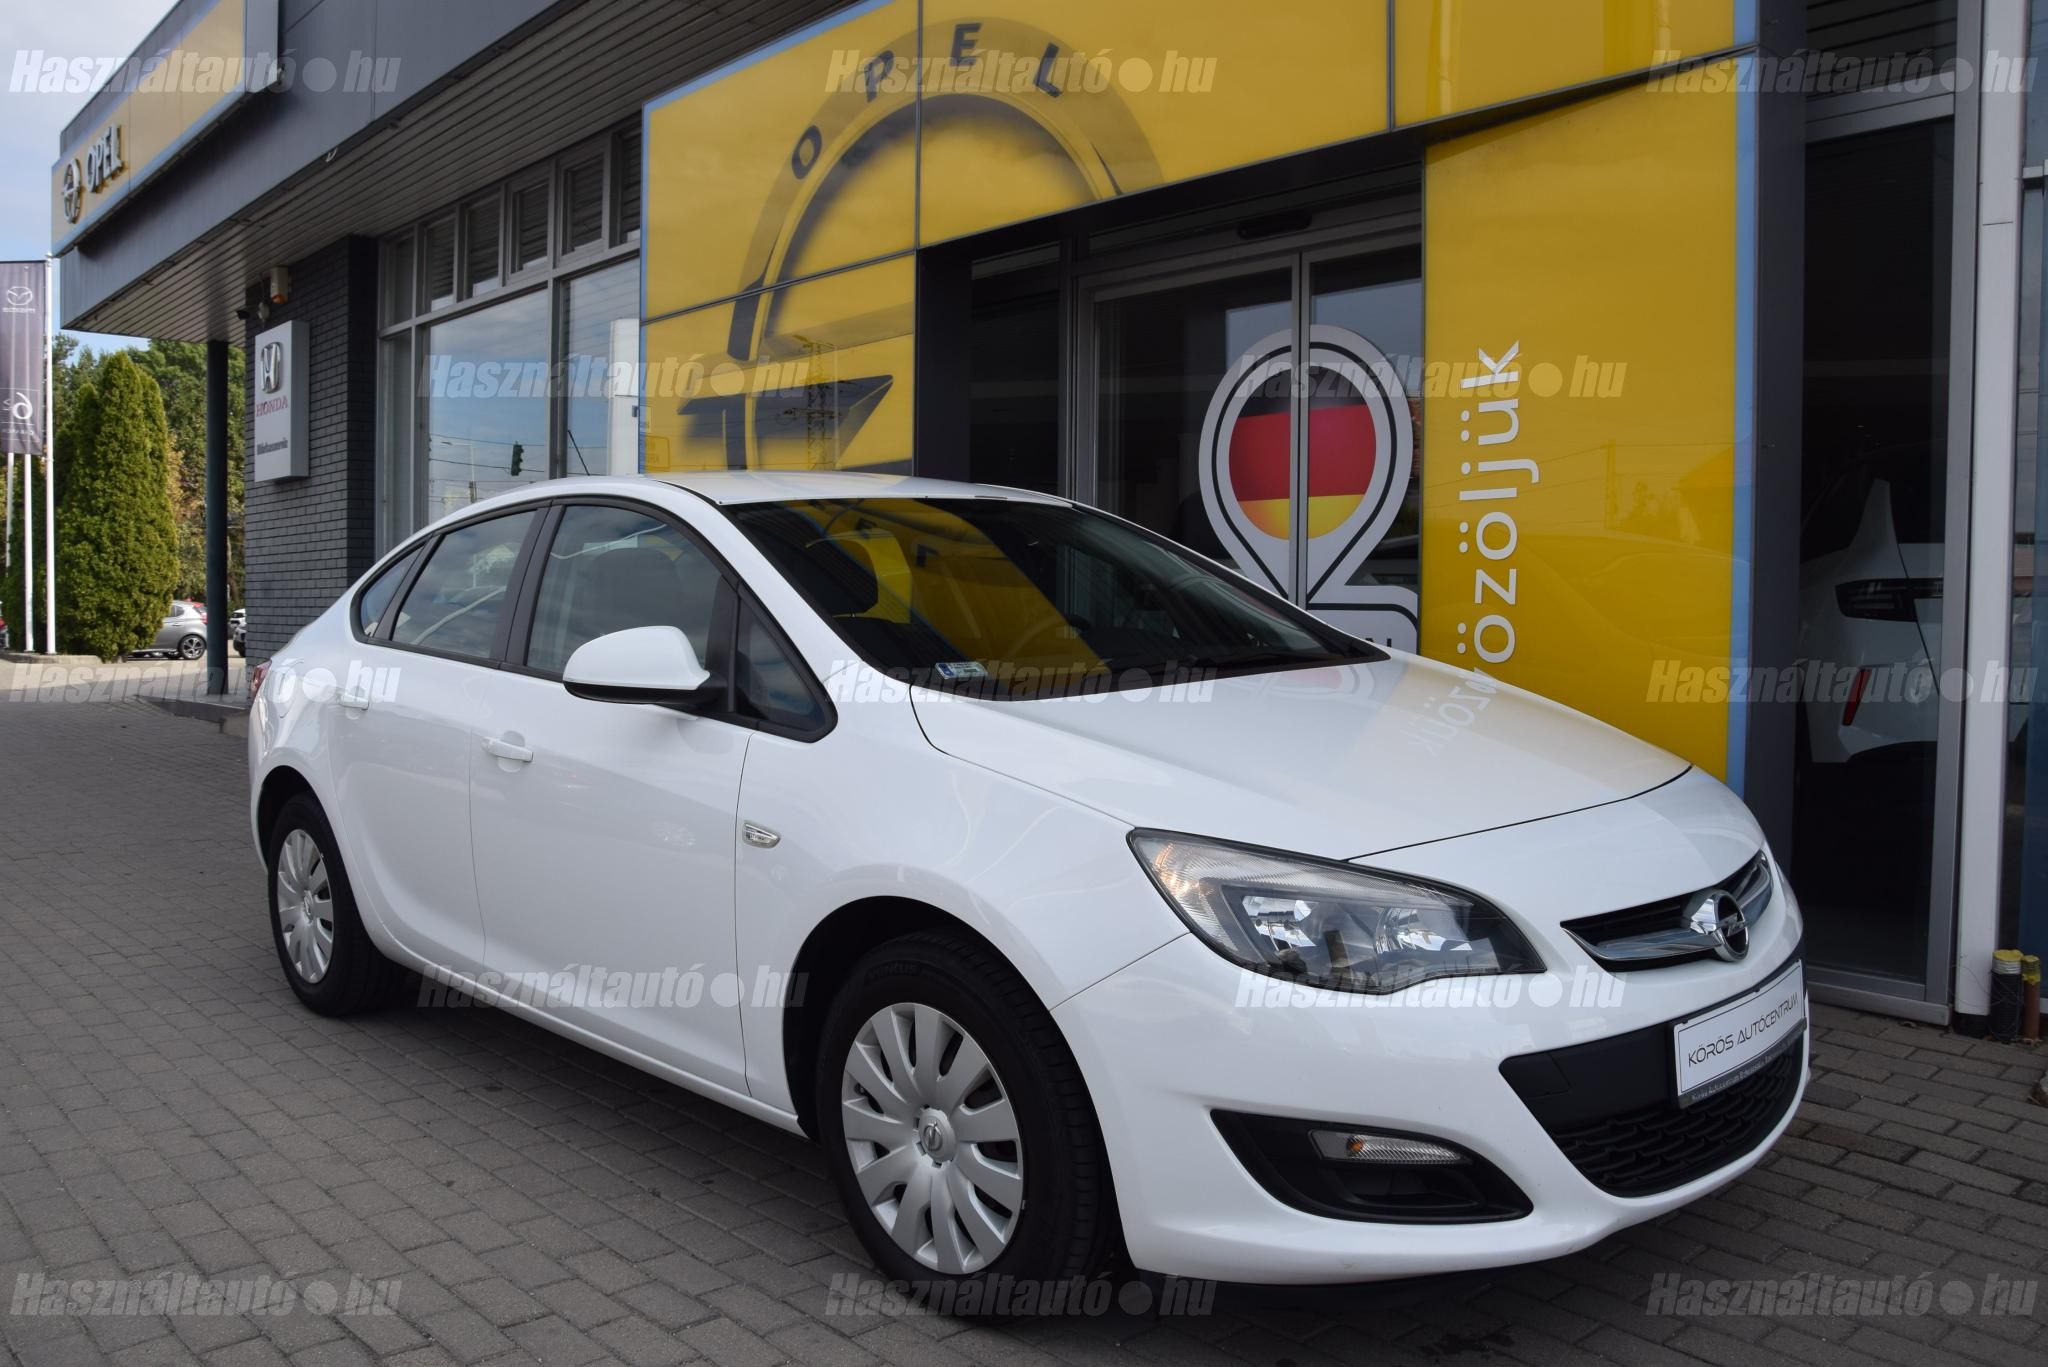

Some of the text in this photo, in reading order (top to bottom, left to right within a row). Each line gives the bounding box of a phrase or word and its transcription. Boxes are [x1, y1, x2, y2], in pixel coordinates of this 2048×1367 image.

[86, 122, 123, 194] OPEL
[791, 22, 1063, 180] OPEL
[256, 395, 288, 417] HONDA
[1456, 339, 1540, 682] özöljük
